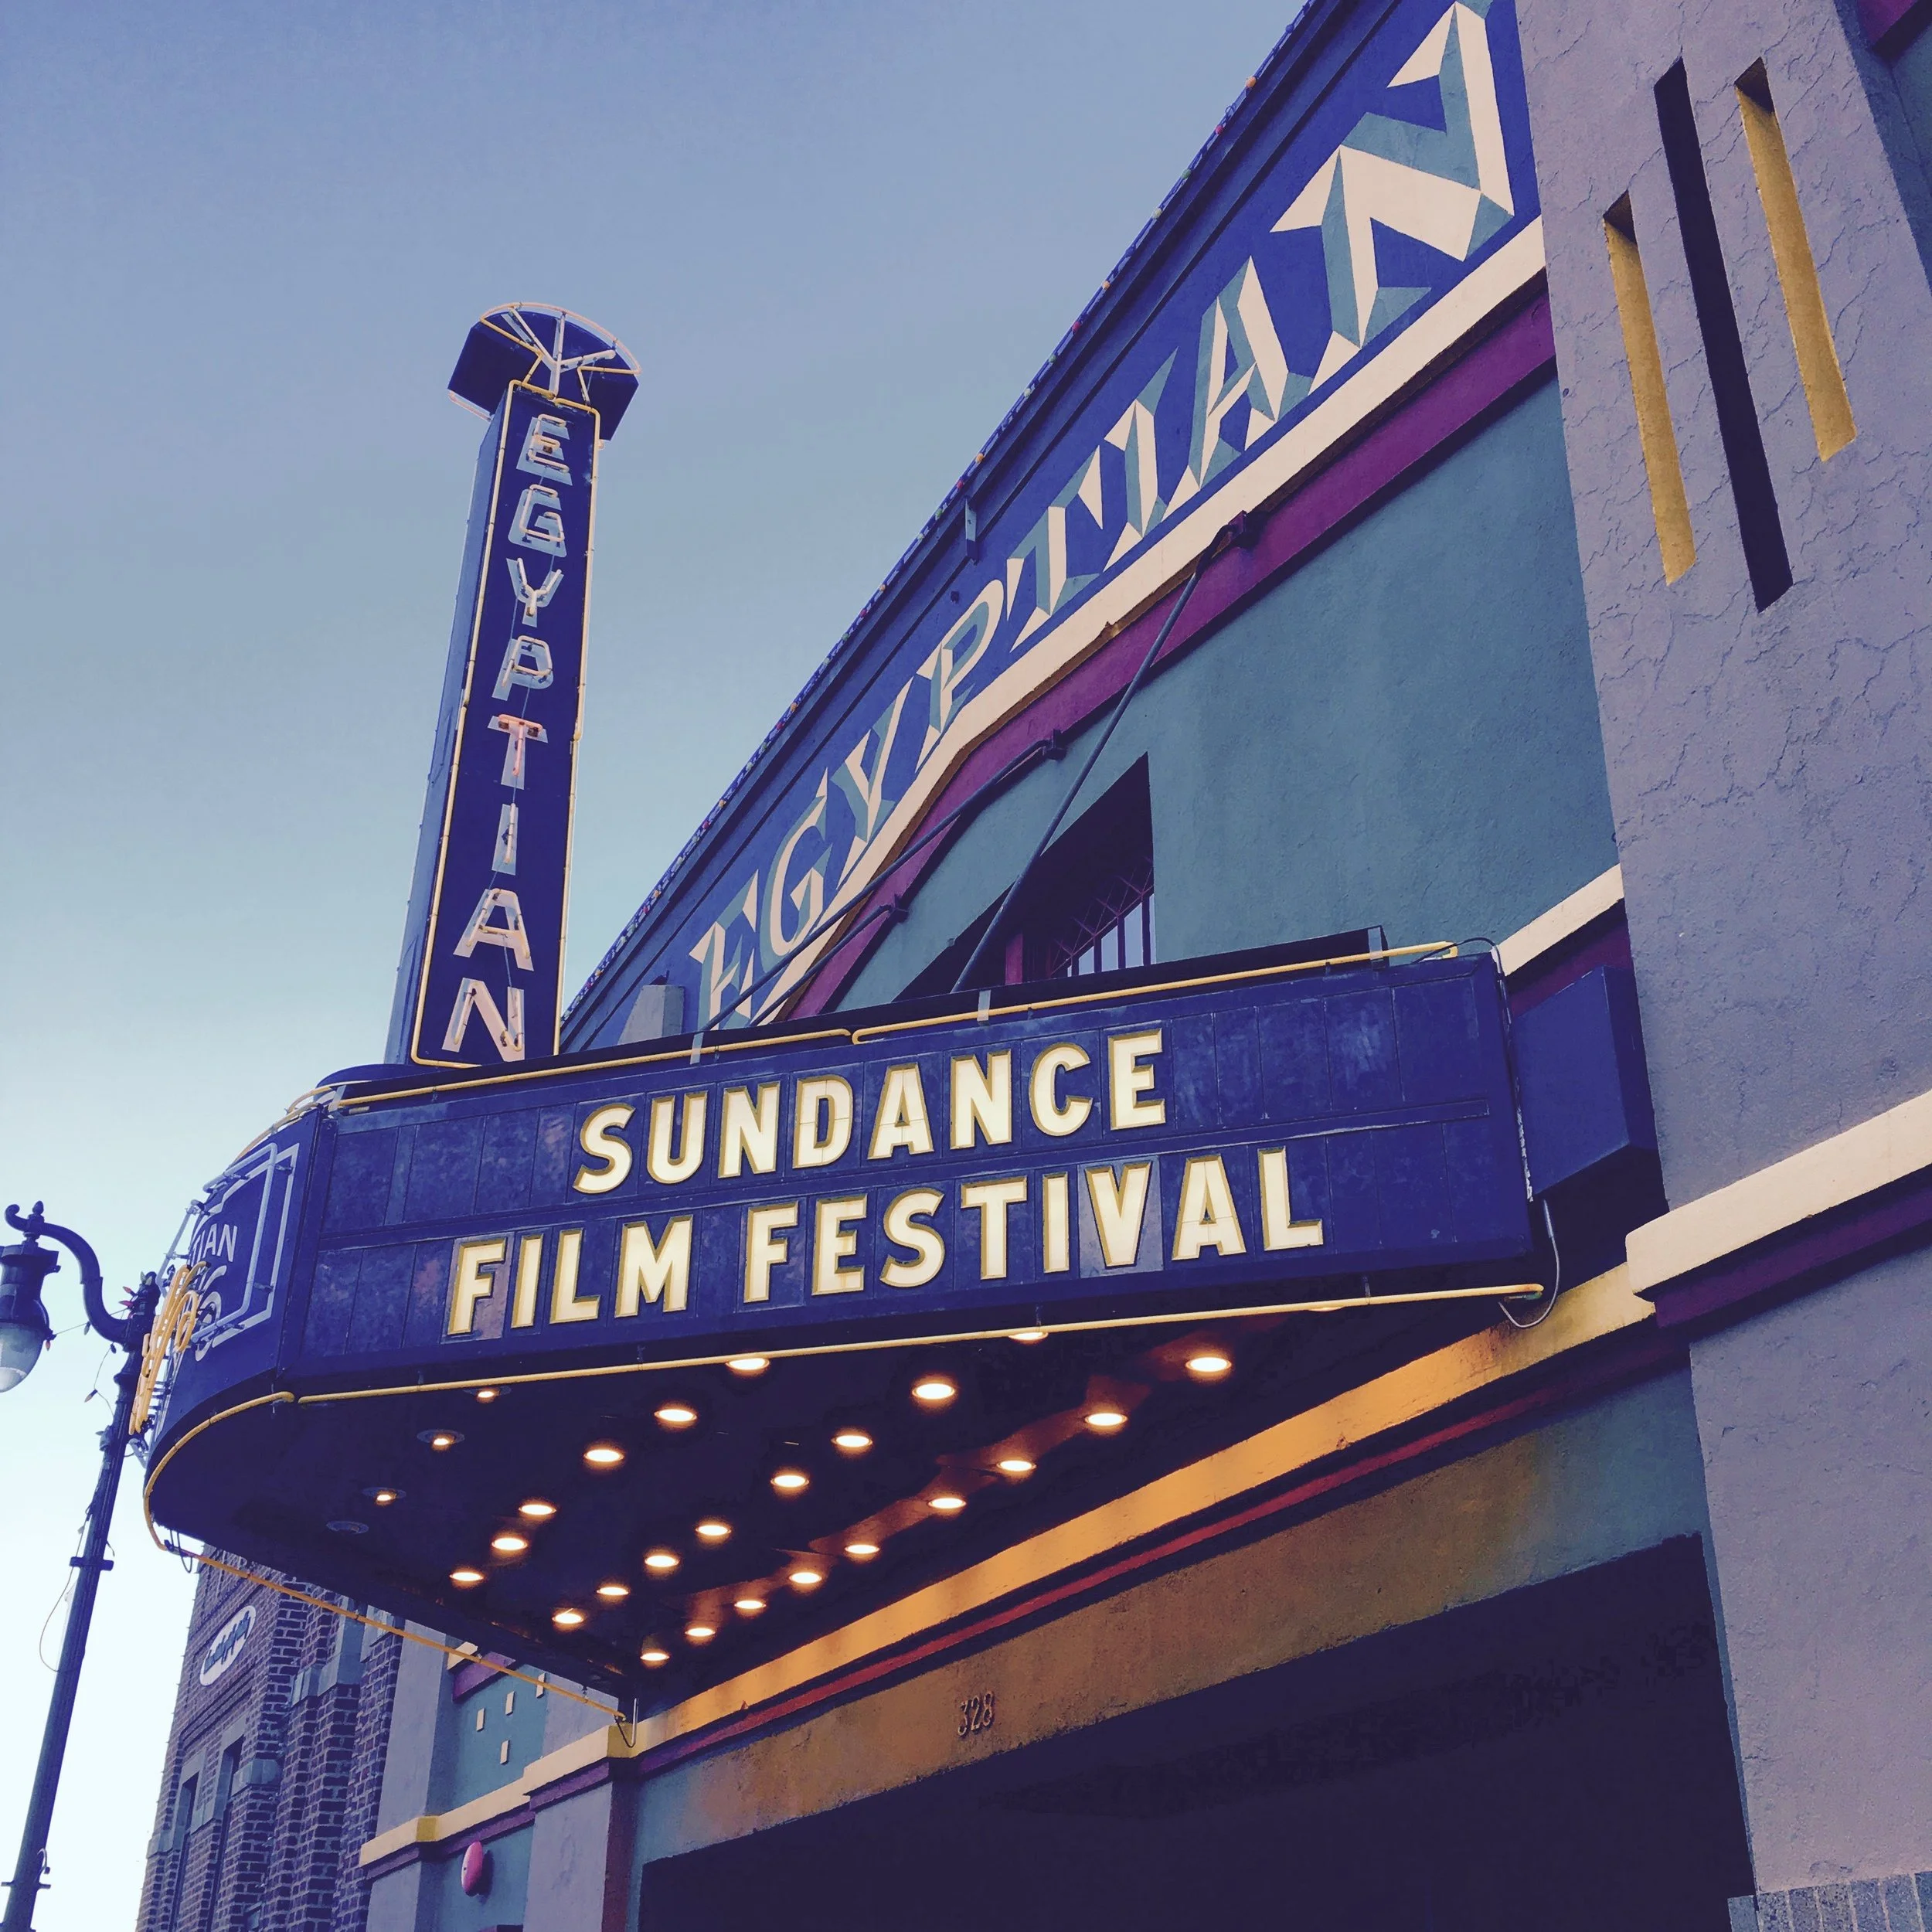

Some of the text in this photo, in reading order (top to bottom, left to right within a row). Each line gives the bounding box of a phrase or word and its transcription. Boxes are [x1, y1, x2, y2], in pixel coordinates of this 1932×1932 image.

[689, 0, 1515, 1031] EGYPTIAN
[441, 413, 573, 1063] EGYPTIAN
[573, 1027, 1166, 1194] SUNDANCE
[447, 1146, 1325, 1335] FILM FESTIVAL
[957, 1690, 995, 1738] 328
